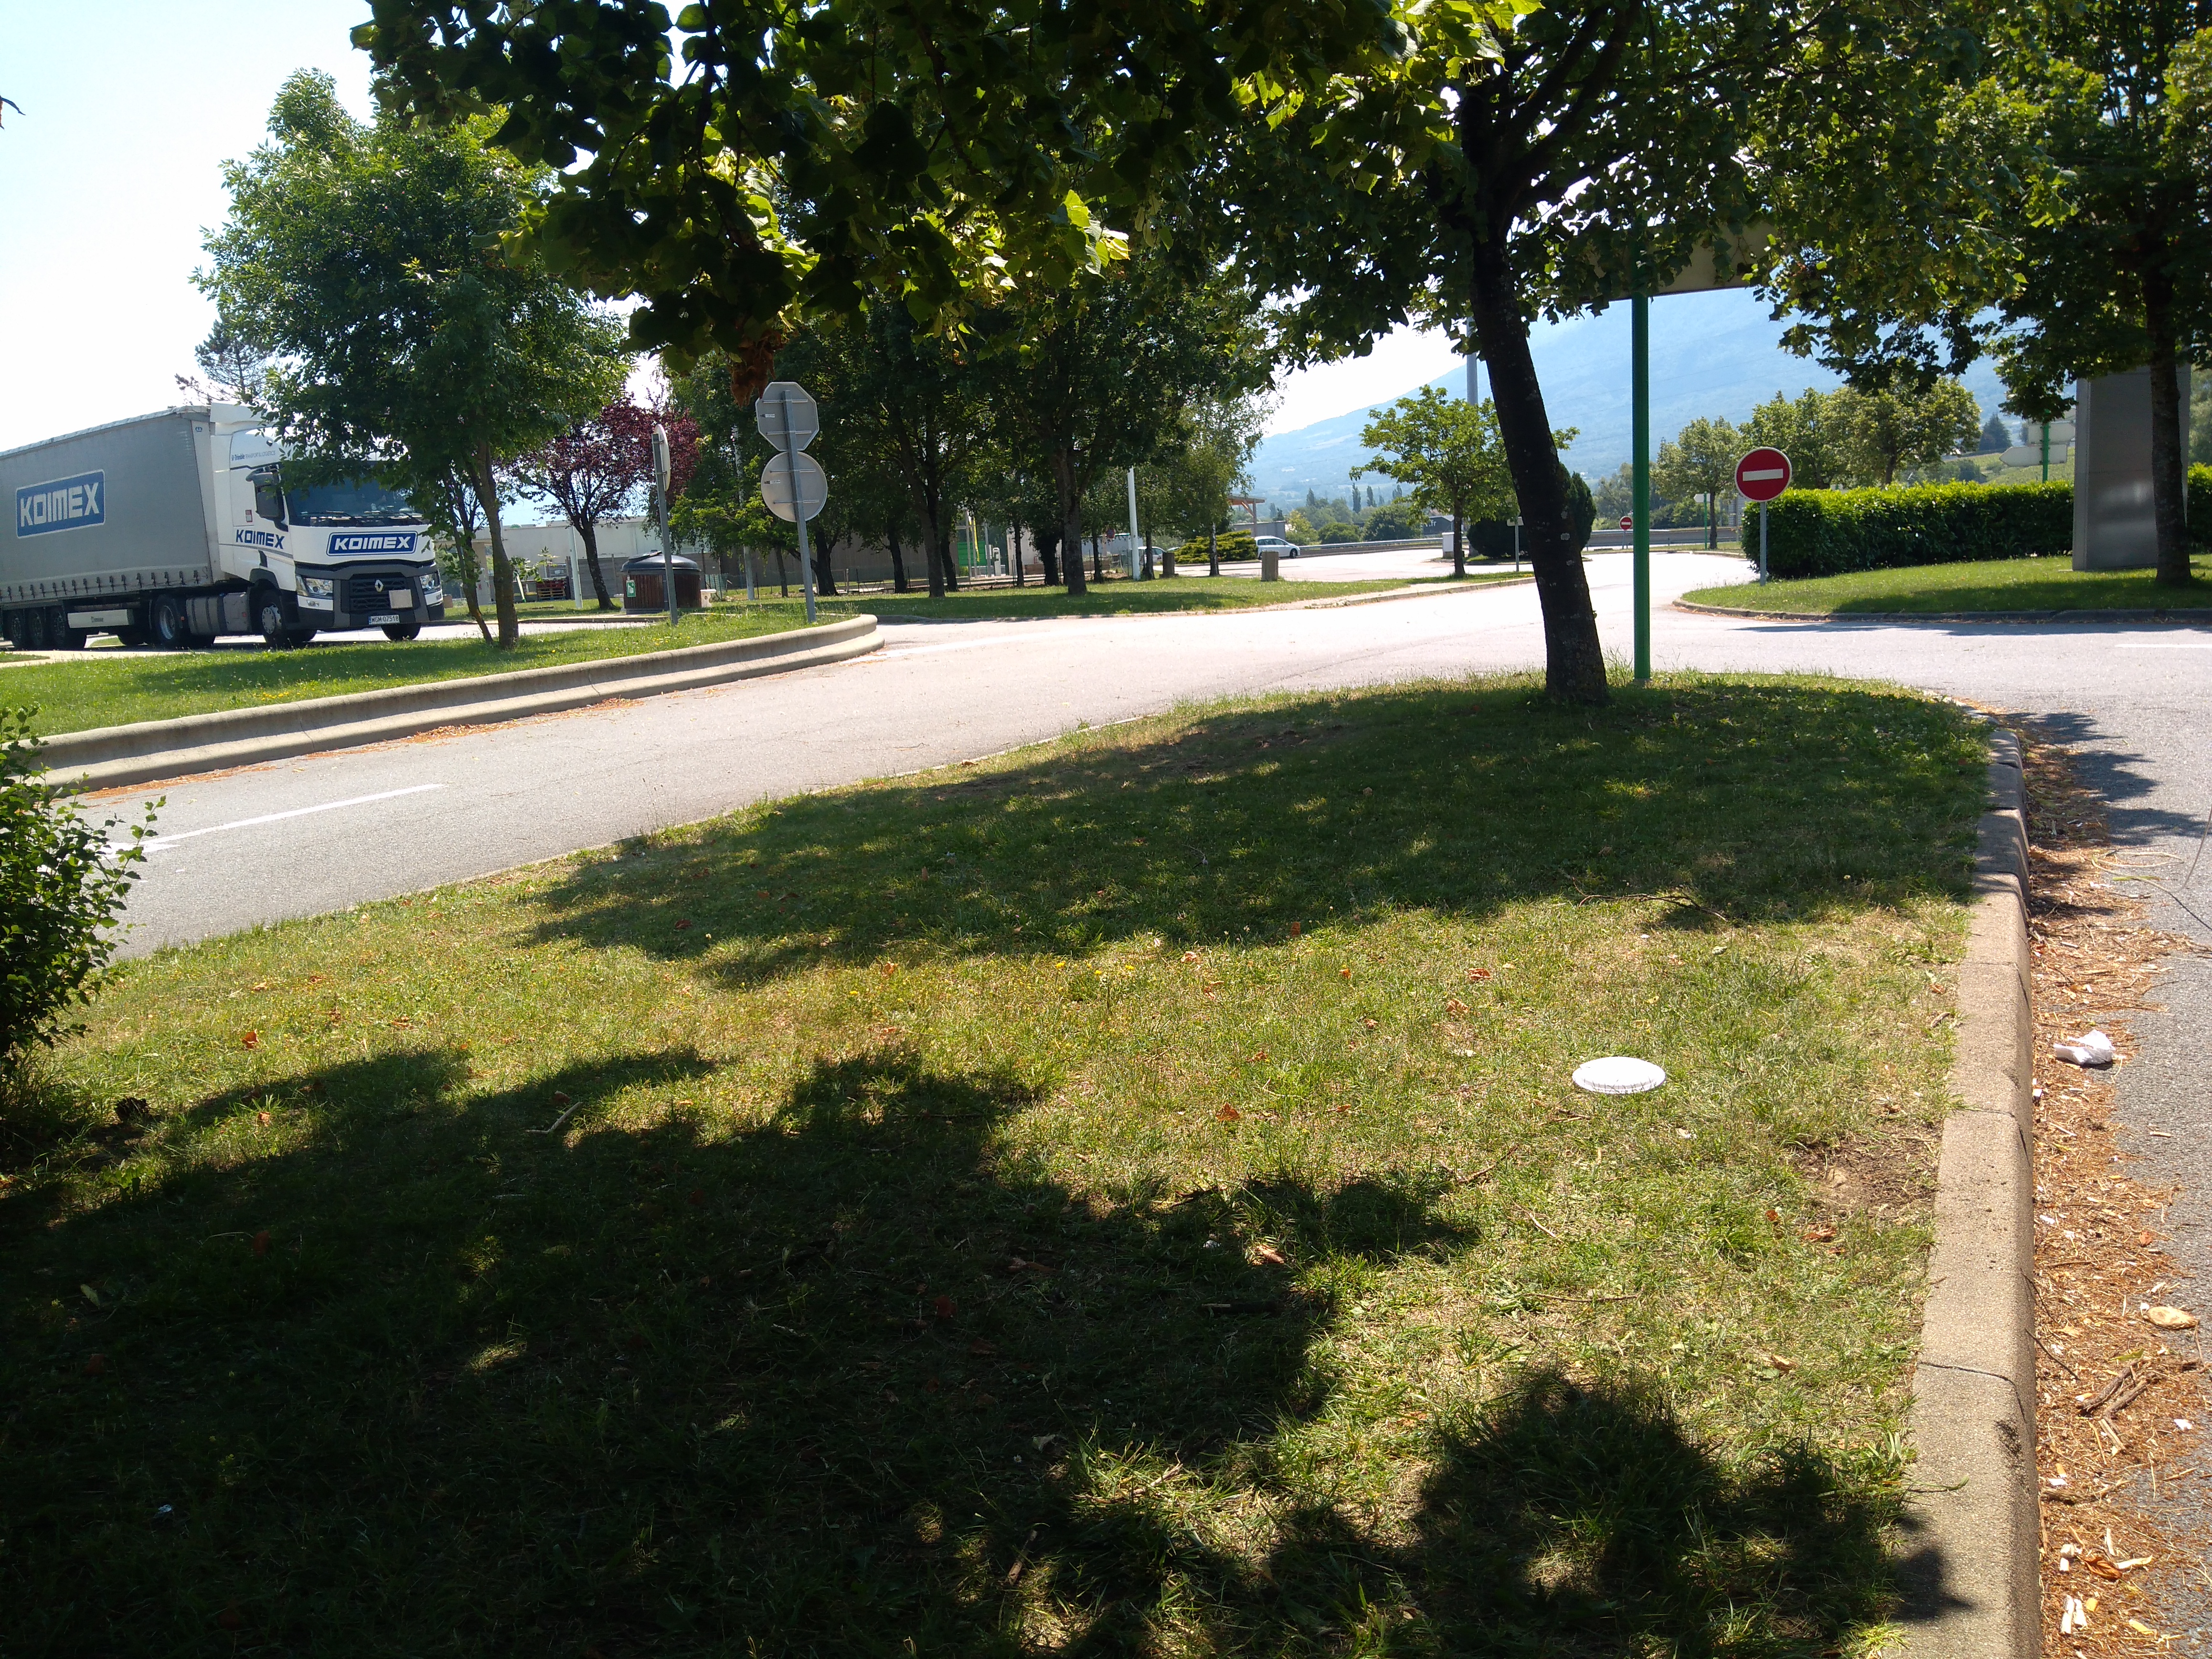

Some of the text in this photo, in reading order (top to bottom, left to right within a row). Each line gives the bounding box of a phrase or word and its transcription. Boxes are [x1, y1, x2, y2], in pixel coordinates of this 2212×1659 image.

[21, 482, 100, 527] KOIMEX
[236, 529, 285, 549] KOIMEX
[334, 536, 411, 550] KOIMEX
